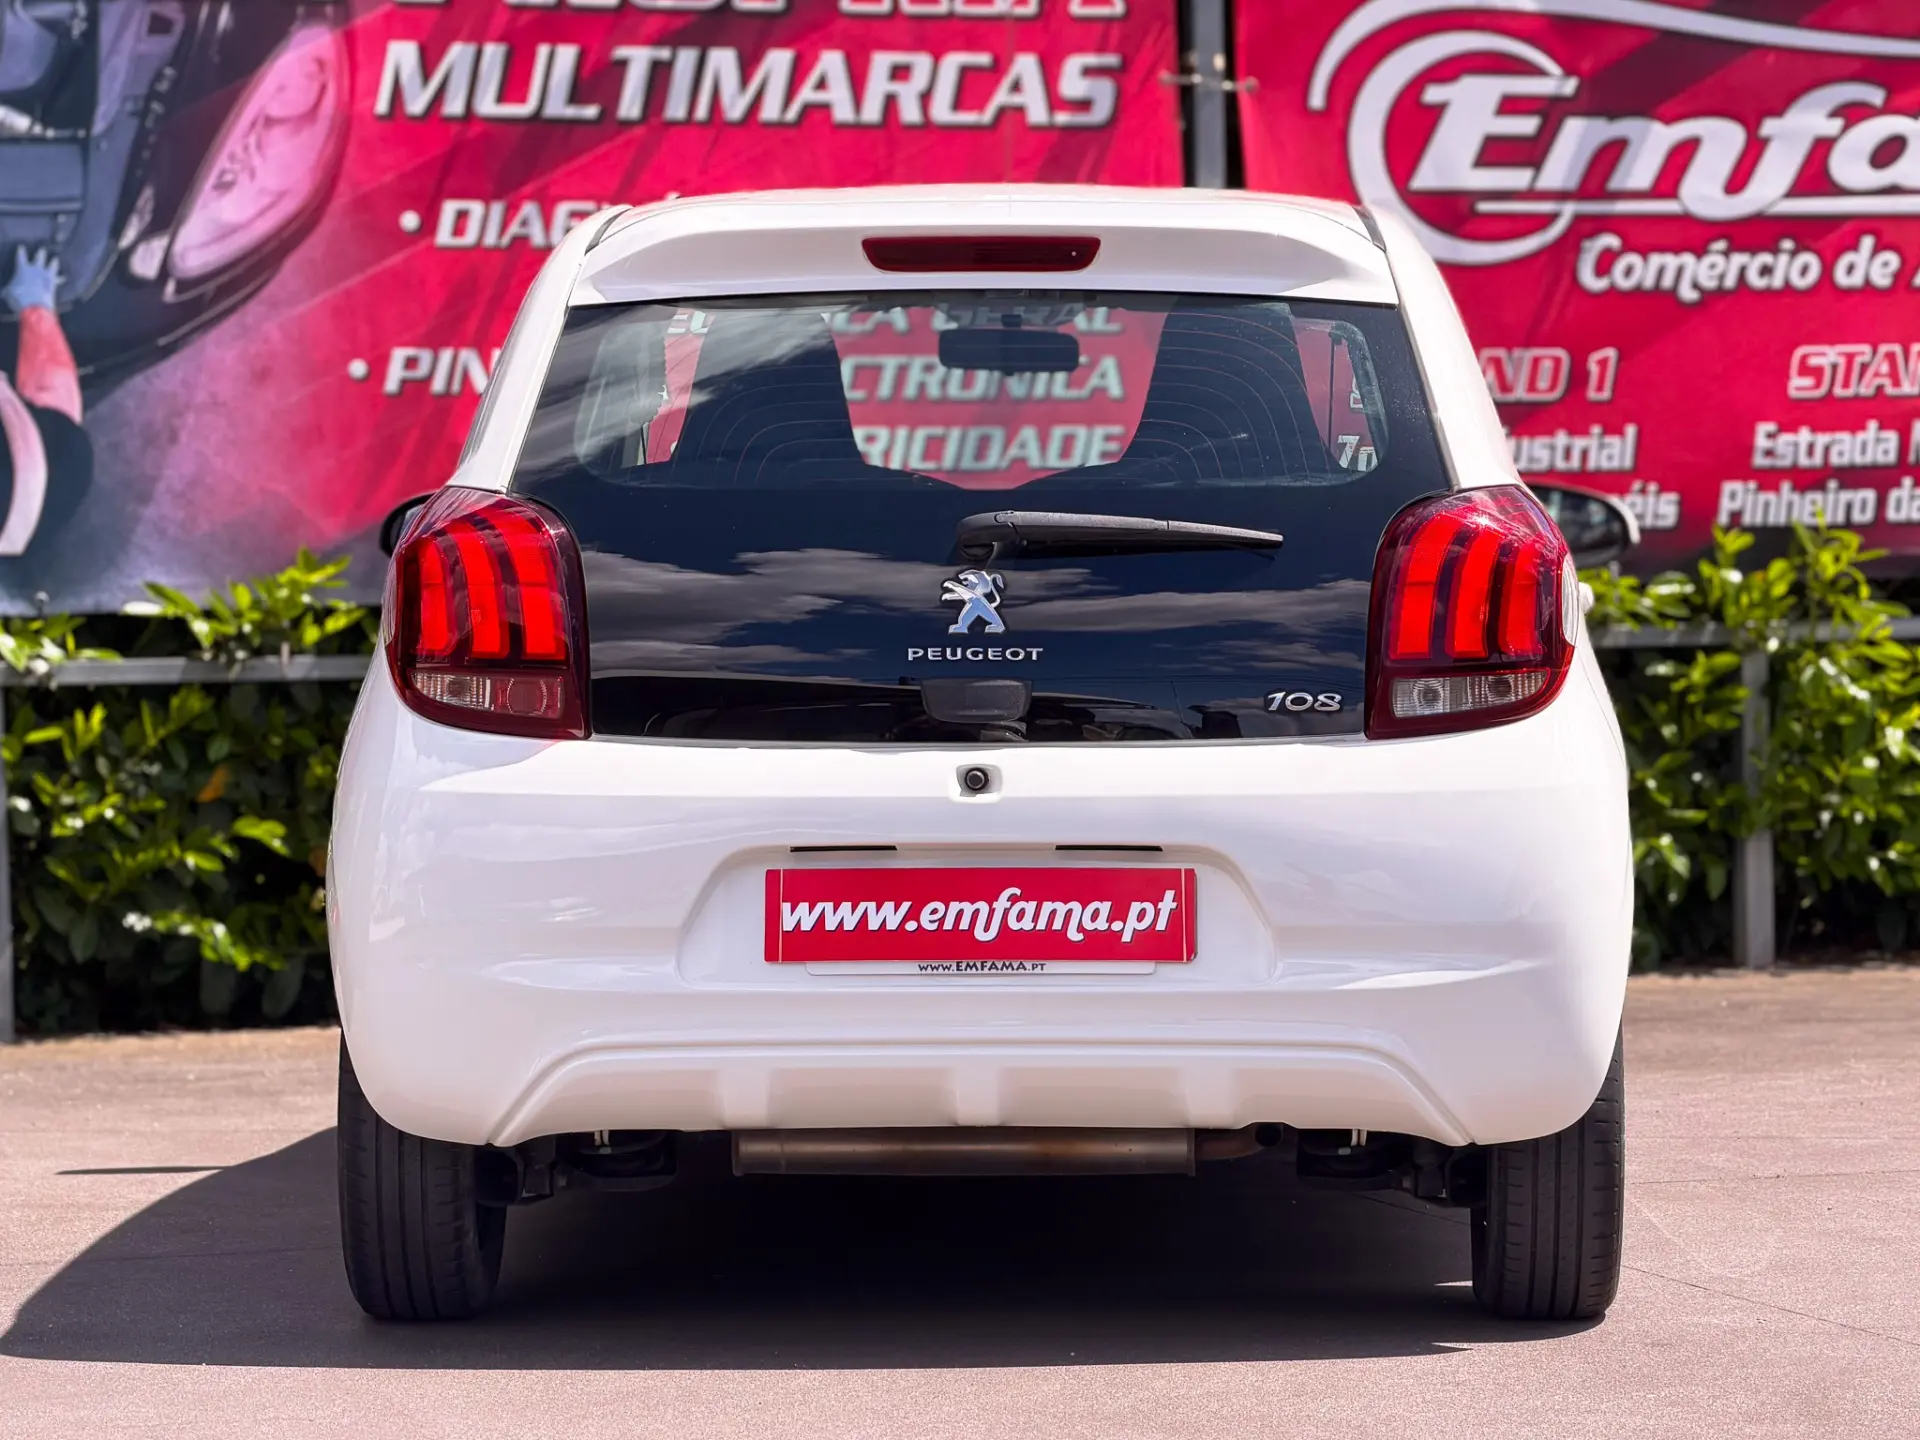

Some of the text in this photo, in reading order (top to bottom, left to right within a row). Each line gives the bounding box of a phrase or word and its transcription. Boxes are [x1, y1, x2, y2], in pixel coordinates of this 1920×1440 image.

[373, 39, 1123, 127] MULTIMARCAS
[1408, 74, 1920, 221] Emfa
[1576, 231, 1822, 304] Comércio
[1833, 234, 1901, 289] de
[1586, 346, 1618, 402] 1
[1503, 422, 1638, 472] ustrial
[1752, 418, 1899, 469] Estrada
[1717, 478, 1878, 527] Pinheiro
[907, 646, 1043, 662] PEUGEOT
[1266, 690, 1343, 712] 108
[782, 886, 1177, 944] www.emfama.pt
